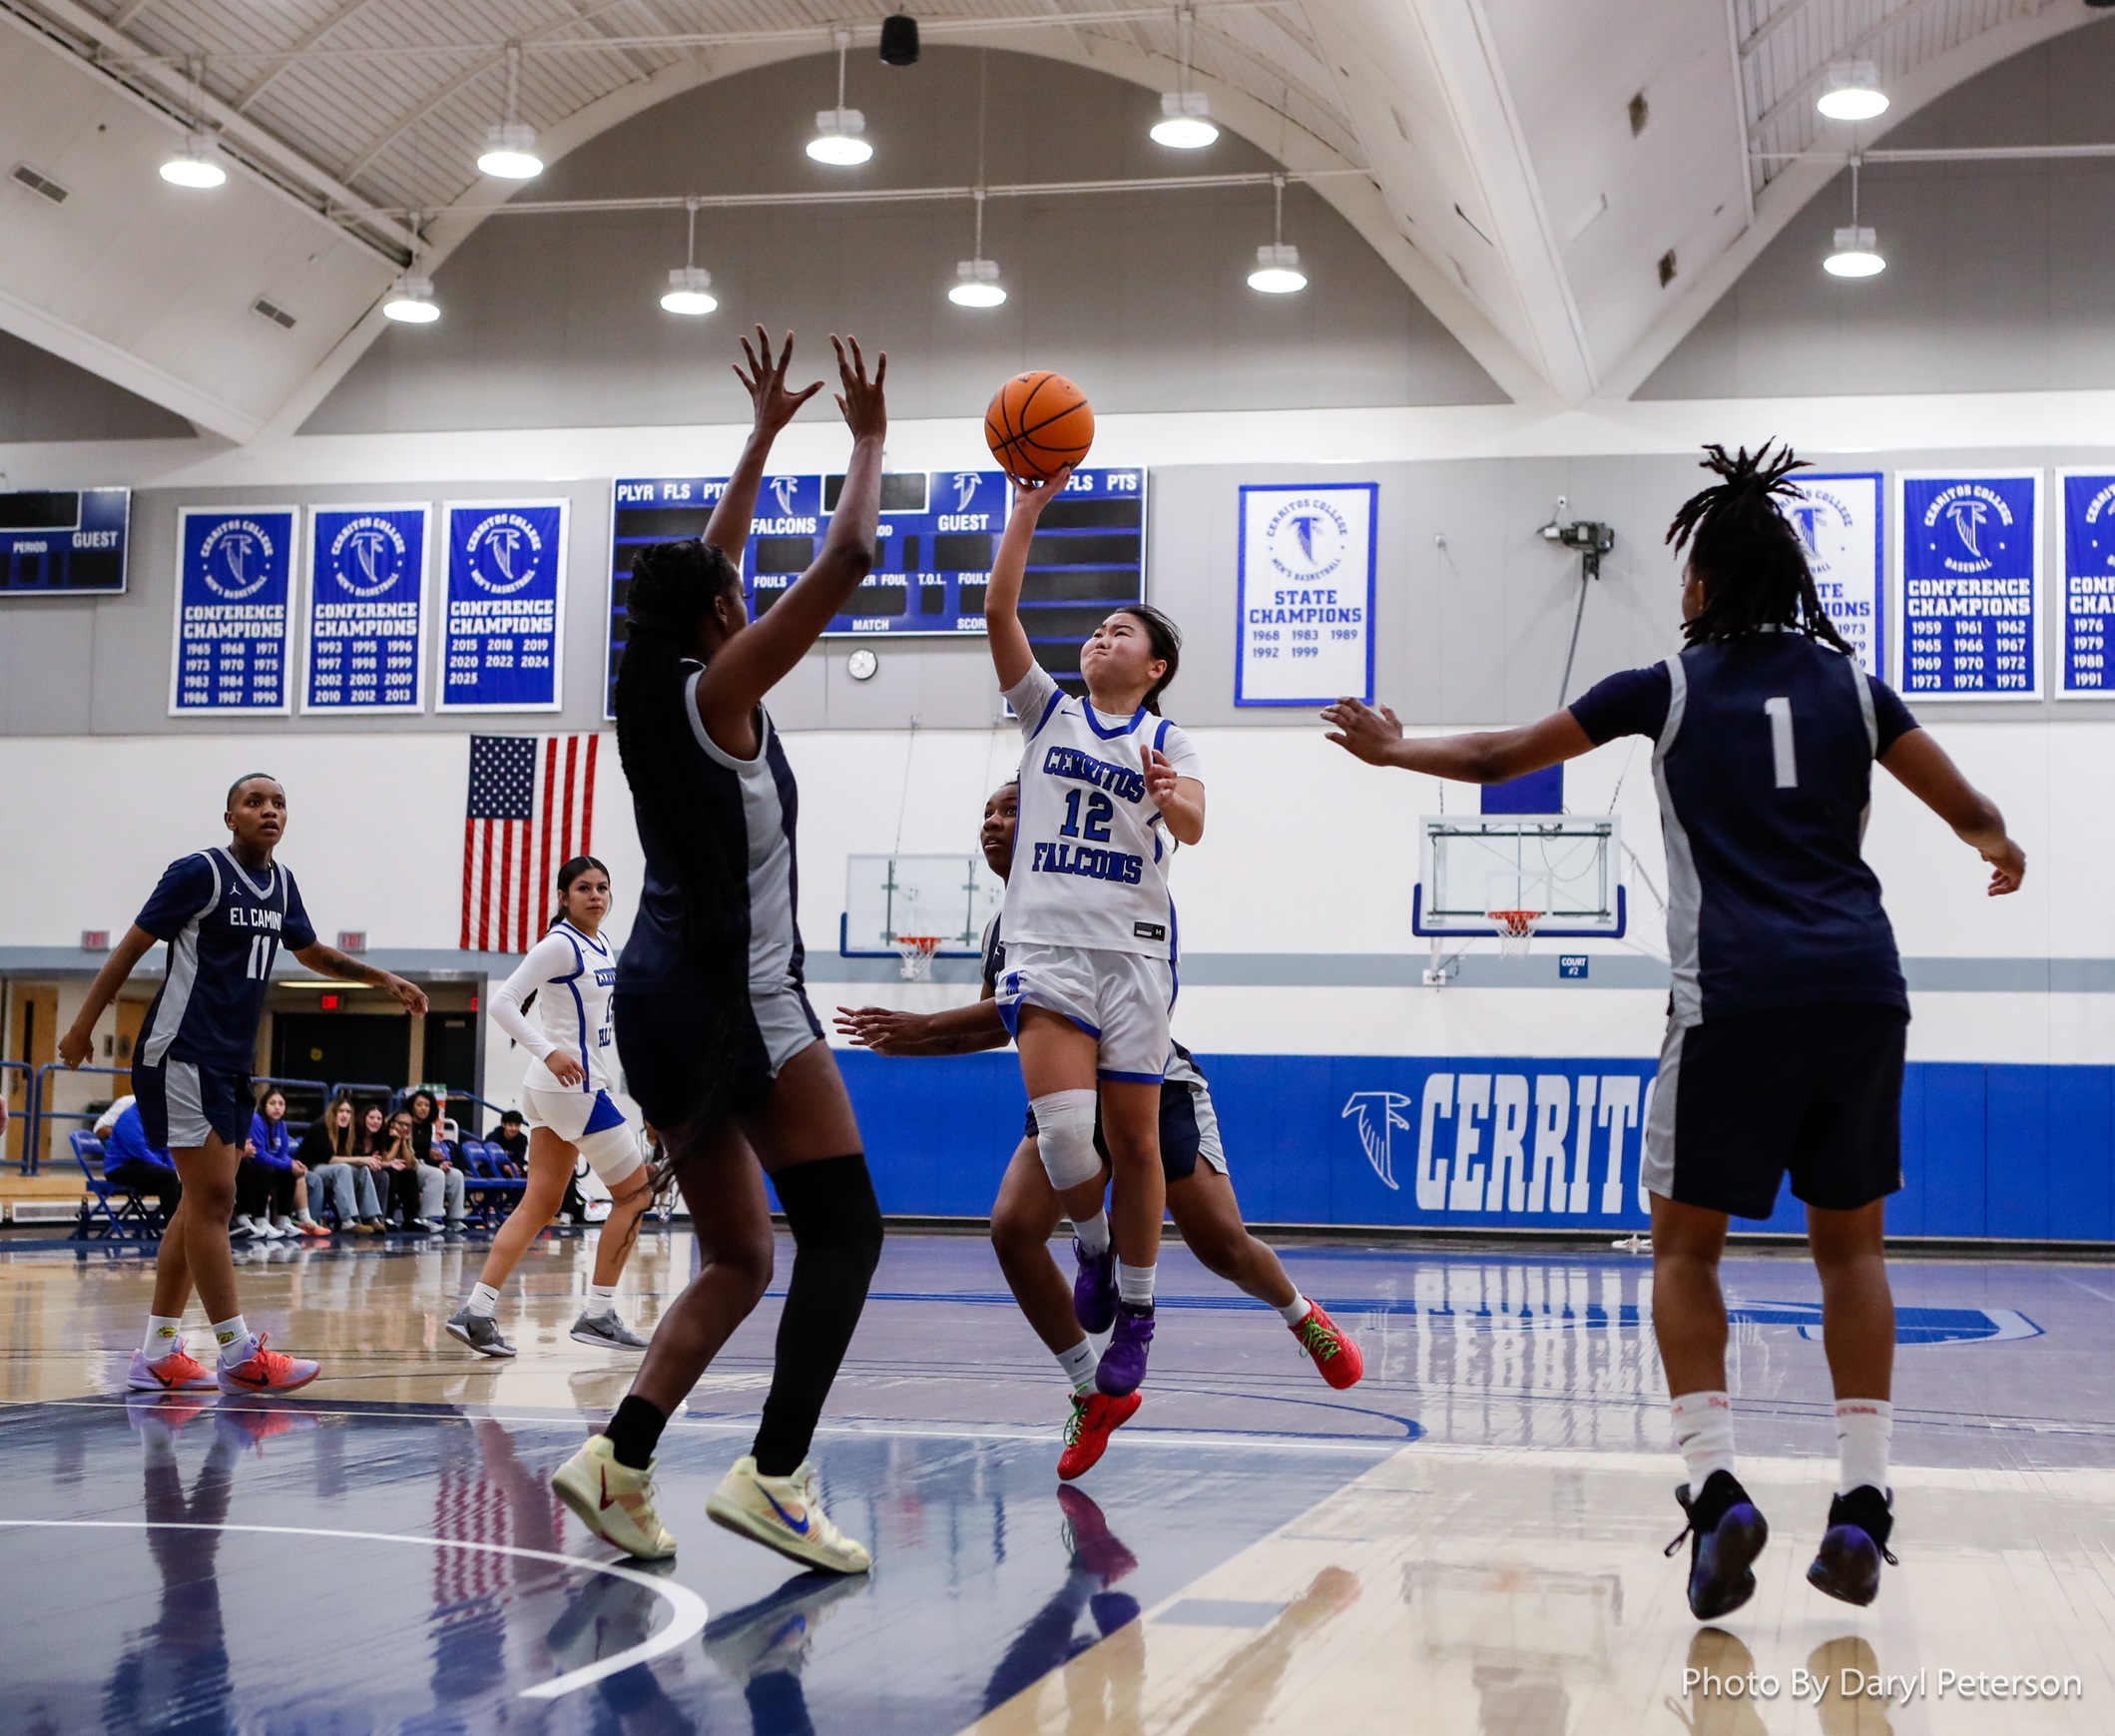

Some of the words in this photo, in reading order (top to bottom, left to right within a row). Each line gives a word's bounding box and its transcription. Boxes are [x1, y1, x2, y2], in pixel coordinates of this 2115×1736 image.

[1107, 474, 1137, 491] PTS
[617, 484, 654, 501] PLYR
[663, 483, 691, 500] FLS
[1924, 484, 1972, 527] CERRITOS
[1974, 485, 2013, 527] COLLEGE
[750, 517, 816, 535] FALCONS
[938, 513, 989, 531] GUEST
[1267, 499, 1310, 537] CERRITOS
[1313, 499, 1347, 535] COLLEGE
[13, 541, 48, 553] PERIOD
[72, 530, 118, 548] GUEST
[1273, 557, 1292, 577] MEN'S
[1294, 557, 1341, 581] BASKETBALL
[1944, 557, 1992, 573] BASEBALL
[754, 575, 788, 588] FOULS
[881, 573, 908, 586] FOUL
[917, 573, 946, 585] T.O.L.
[1908, 578, 2030, 597] CONFERENCE
[1275, 589, 1337, 605] STATE
[2070, 595, 2115, 614] CHA
[185, 605, 284, 621] CONFERENCE
[315, 602, 417, 619] CONFERENCE
[450, 599, 553, 616] CONFERENCE
[1250, 607, 1361, 623] CHAMPIONS
[1908, 597, 2030, 617] CHAMPIONS
[184, 622, 283, 639] CHAMPIONS
[314, 619, 417, 637] CHAMPIONS
[449, 617, 553, 635] CHAMPIONS
[852, 619, 888, 631] MATCH
[957, 618, 988, 629] SCOR
[1839, 623, 1865, 635] 1973
[1912, 621, 1941, 635] 1959
[1955, 621, 1982, 635] 1961
[1996, 621, 2026, 635] 1962
[2074, 618, 2104, 633] 1976
[1254, 630, 1280, 641] 1968
[1292, 630, 1319, 641] 1983
[1331, 630, 1357, 641] 1989
[2074, 636, 2104, 651] 1979
[256, 643, 277, 655] 1971
[317, 641, 342, 653] 1993
[352, 641, 377, 653] 1995
[387, 641, 412, 653] 1996
[451, 639, 477, 651] 2015
[487, 639, 513, 651] 2018
[523, 639, 549, 651] 2019
[1254, 647, 1279, 658] 1992
[1292, 647, 1318, 658] 1999
[1912, 639, 1941, 653] 1965
[1954, 639, 1984, 653] 1966
[1996, 639, 2026, 653] 1967
[255, 659, 278, 671] 1975
[317, 657, 341, 670] 1997
[351, 657, 376, 670] 1998
[387, 657, 411, 670] 1999
[449, 655, 478, 668] 2020
[485, 655, 513, 668] 2022
[521, 655, 549, 668] 2024
[1912, 656, 1941, 671] 1969
[1954, 656, 1984, 671] 1970
[1996, 656, 2026, 671] 1972
[2074, 654, 2104, 669] 1988
[314, 673, 341, 687] 2002
[349, 673, 377, 687] 2003
[384, 673, 412, 687] 2009
[449, 672, 478, 685] 2025
[1912, 675, 1941, 689] 1973
[1954, 675, 1984, 689] 1974
[1996, 675, 2026, 689] 1975
[2075, 671, 2102, 687] 1991
[315, 689, 340, 703] 2010
[350, 689, 375, 703] 2012
[385, 689, 410, 703] 2013
[1764, 697, 1799, 789] 1
[1043, 747, 1146, 804] CERRITOS
[1060, 789, 1114, 843] 12
[1032, 843, 1143, 884] FALCONS
[230, 907, 248, 926] EL
[247, 934, 271, 980] 11
[1569, 966, 1579, 975] #2
[1415, 1072, 1657, 1215] CERRIT
